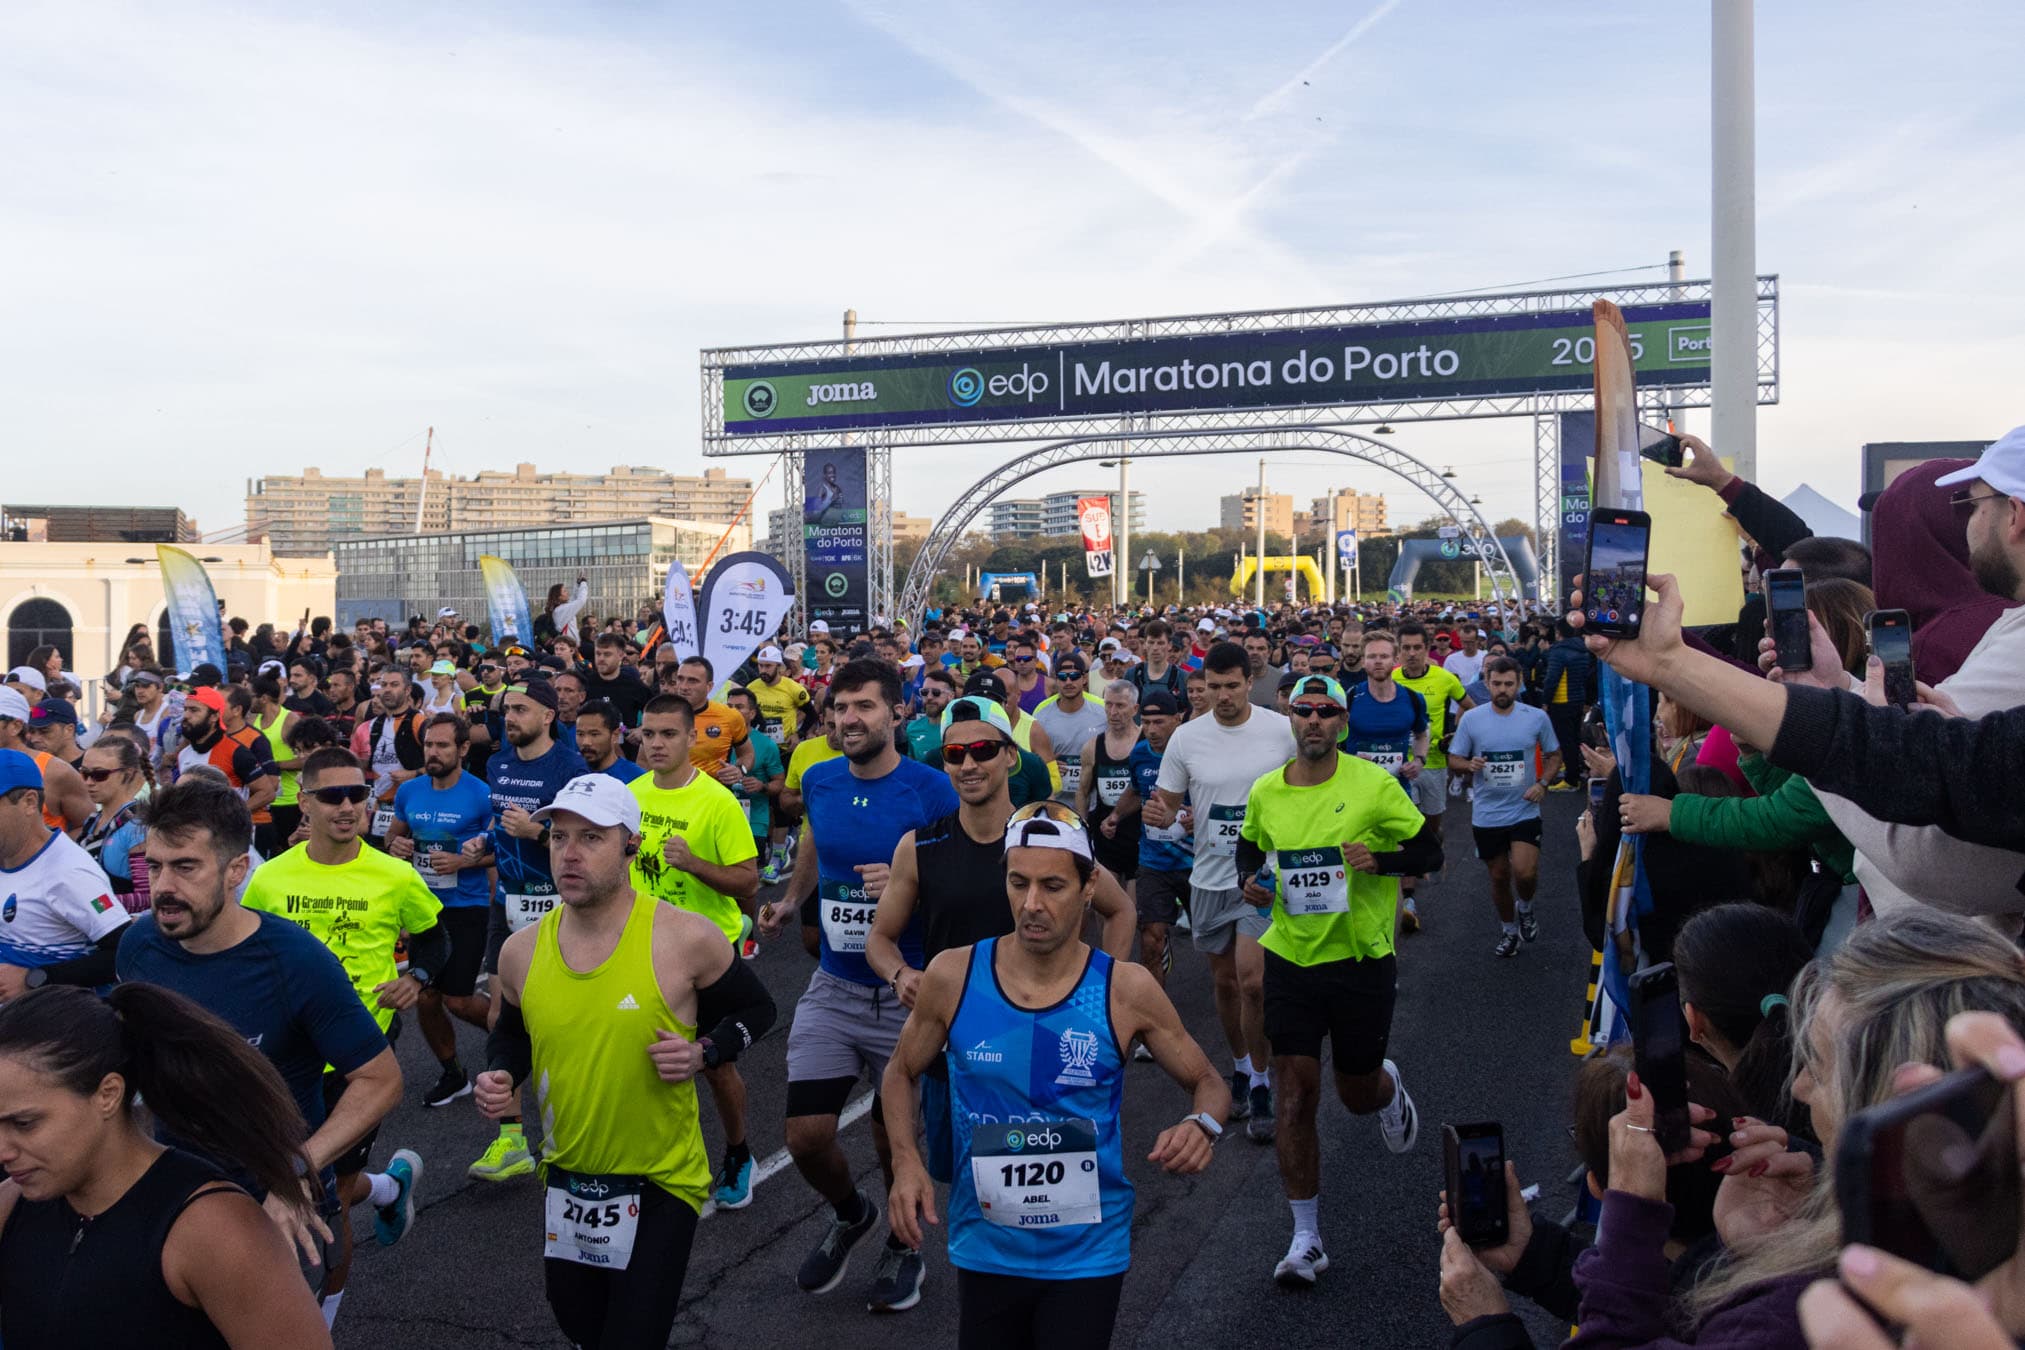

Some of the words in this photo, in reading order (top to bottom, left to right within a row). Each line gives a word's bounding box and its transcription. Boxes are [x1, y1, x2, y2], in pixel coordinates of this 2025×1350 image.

[1551, 333, 1644, 365] 205
[988, 363, 1048, 402] edp
[1075, 358, 1271, 396] Maratona
[1282, 349, 1334, 384] do
[1344, 344, 1459, 381] Porto
[1566, 511, 1584, 523] do
[809, 526, 862, 537] Maratona
[817, 537, 831, 548] do
[833, 537, 863, 548] Porto
[721, 608, 767, 635] 3:45
[1116, 768, 1129, 776] edp
[1490, 764, 1515, 773] 2621
[511, 779, 544, 787] HYUNDAI
[416, 811, 432, 822] edp
[1302, 851, 1323, 865] edp
[1289, 872, 1330, 888] 4129
[535, 882, 553, 894] edp
[302, 896, 334, 909] Grande
[520, 899, 554, 912] 3119
[966, 1050, 1002, 1063] STADIO
[1027, 1128, 1062, 1150] edp
[1000, 1161, 1065, 1188] 1120
[580, 1179, 609, 1197] edp
[1023, 1194, 1051, 1204] ABEL
[563, 1199, 620, 1228] 2745
[575, 1231, 610, 1244] ANTONIO
